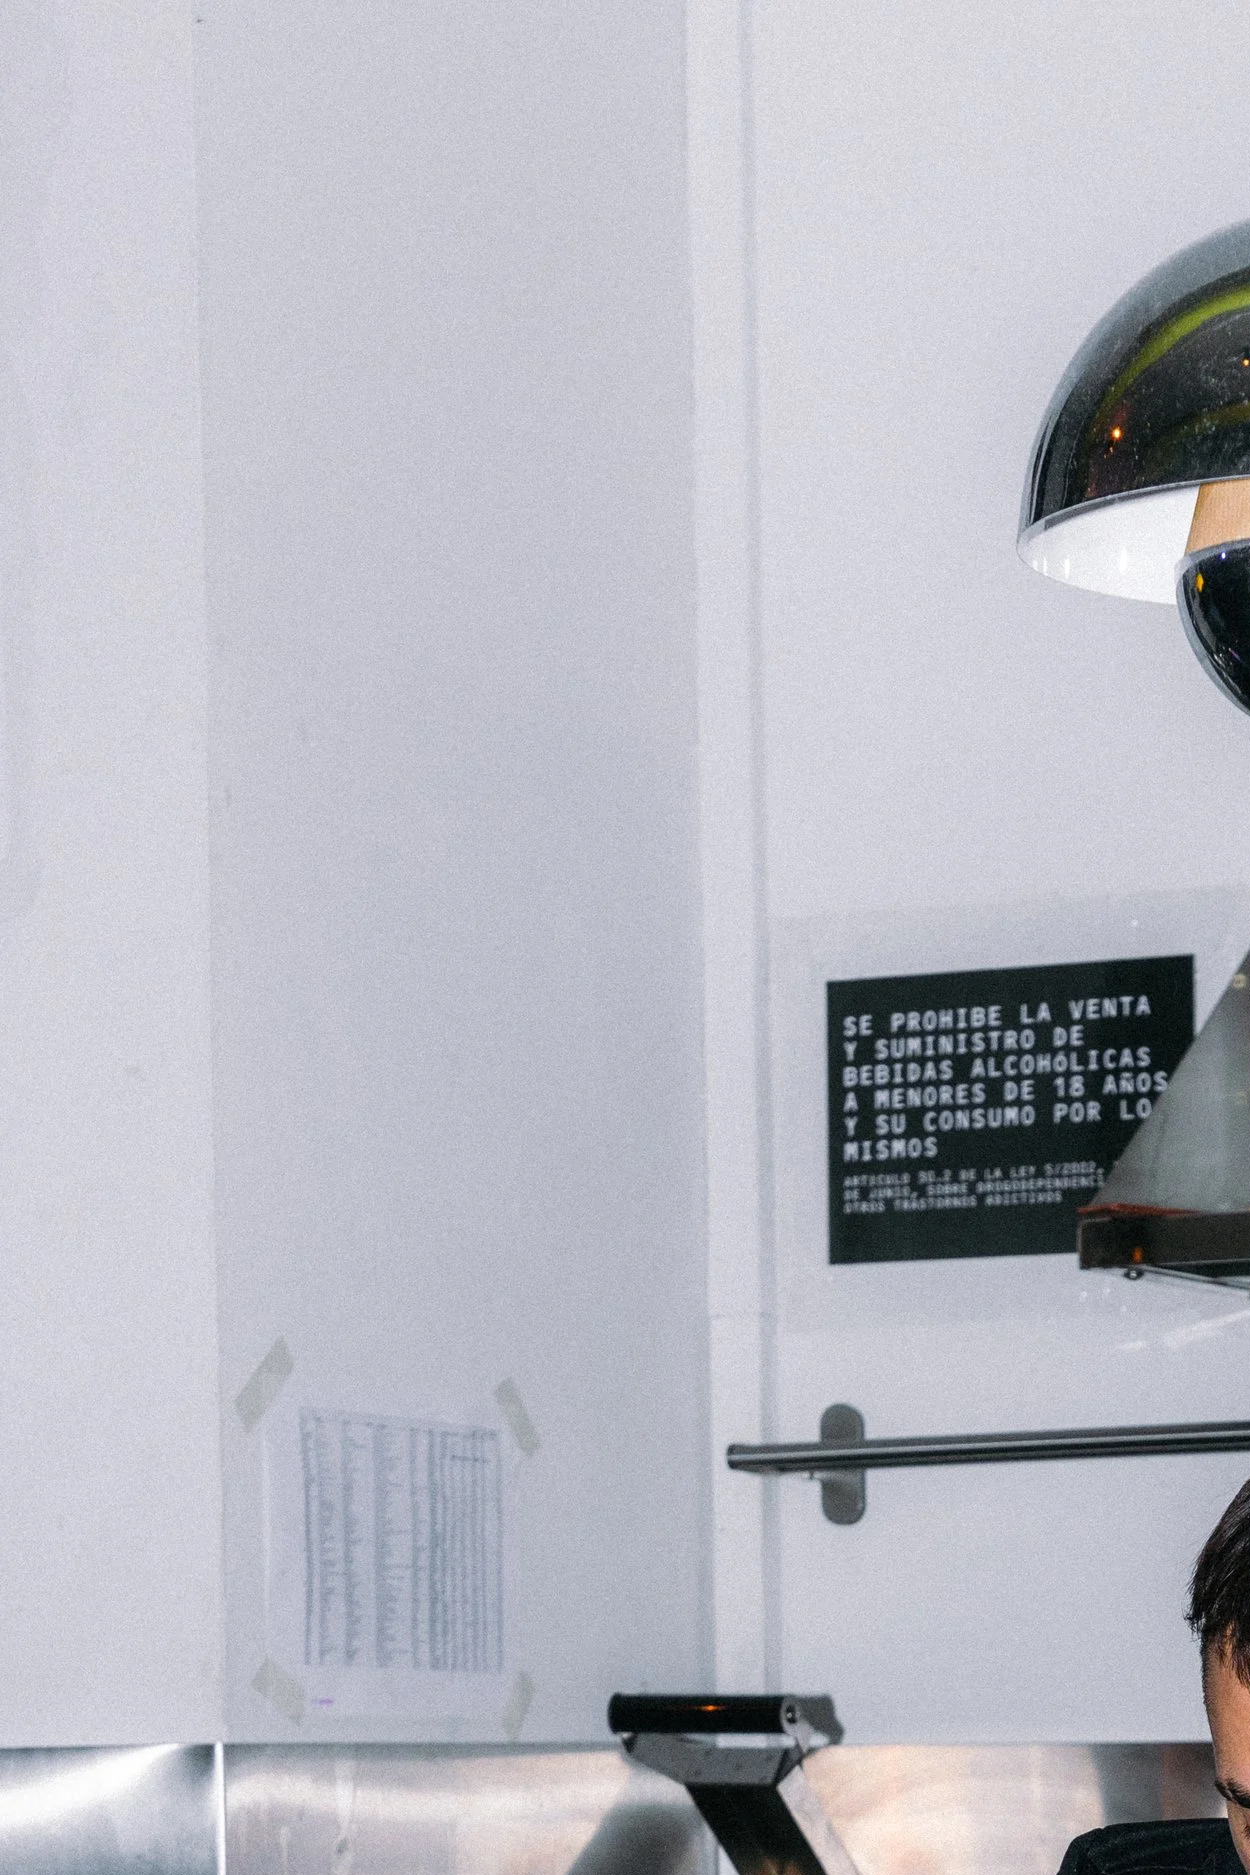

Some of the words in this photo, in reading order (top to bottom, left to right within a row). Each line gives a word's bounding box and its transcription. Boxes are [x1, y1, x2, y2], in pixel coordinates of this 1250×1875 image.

[842, 1014, 873, 1037] SE
[890, 1004, 1002, 1033] PROHIBE
[1020, 1002, 1052, 1025] LA
[1068, 995, 1151, 1020] VENTA
[843, 1040, 858, 1061] Y
[874, 1028, 1035, 1060] SUMINISTRO
[1052, 1024, 1085, 1048] DE
[842, 1059, 954, 1088] BEBIDAS
[970, 1046, 1151, 1078] ALCOHÓLICAS
[843, 1091, 859, 1112] A
[874, 1082, 987, 1110] MENORES
[1003, 1079, 1035, 1102] DE
[1053, 1074, 1085, 1098] 18
[1101, 1070, 1169, 1096] AÑOS
[844, 1115, 858, 1137] Y
[875, 1113, 906, 1136] SU
[922, 1104, 1036, 1133] CONSUMO
[1053, 1101, 1101, 1124] POR
[1119, 1097, 1152, 1121] LO
[843, 1136, 938, 1163] MISMOS
